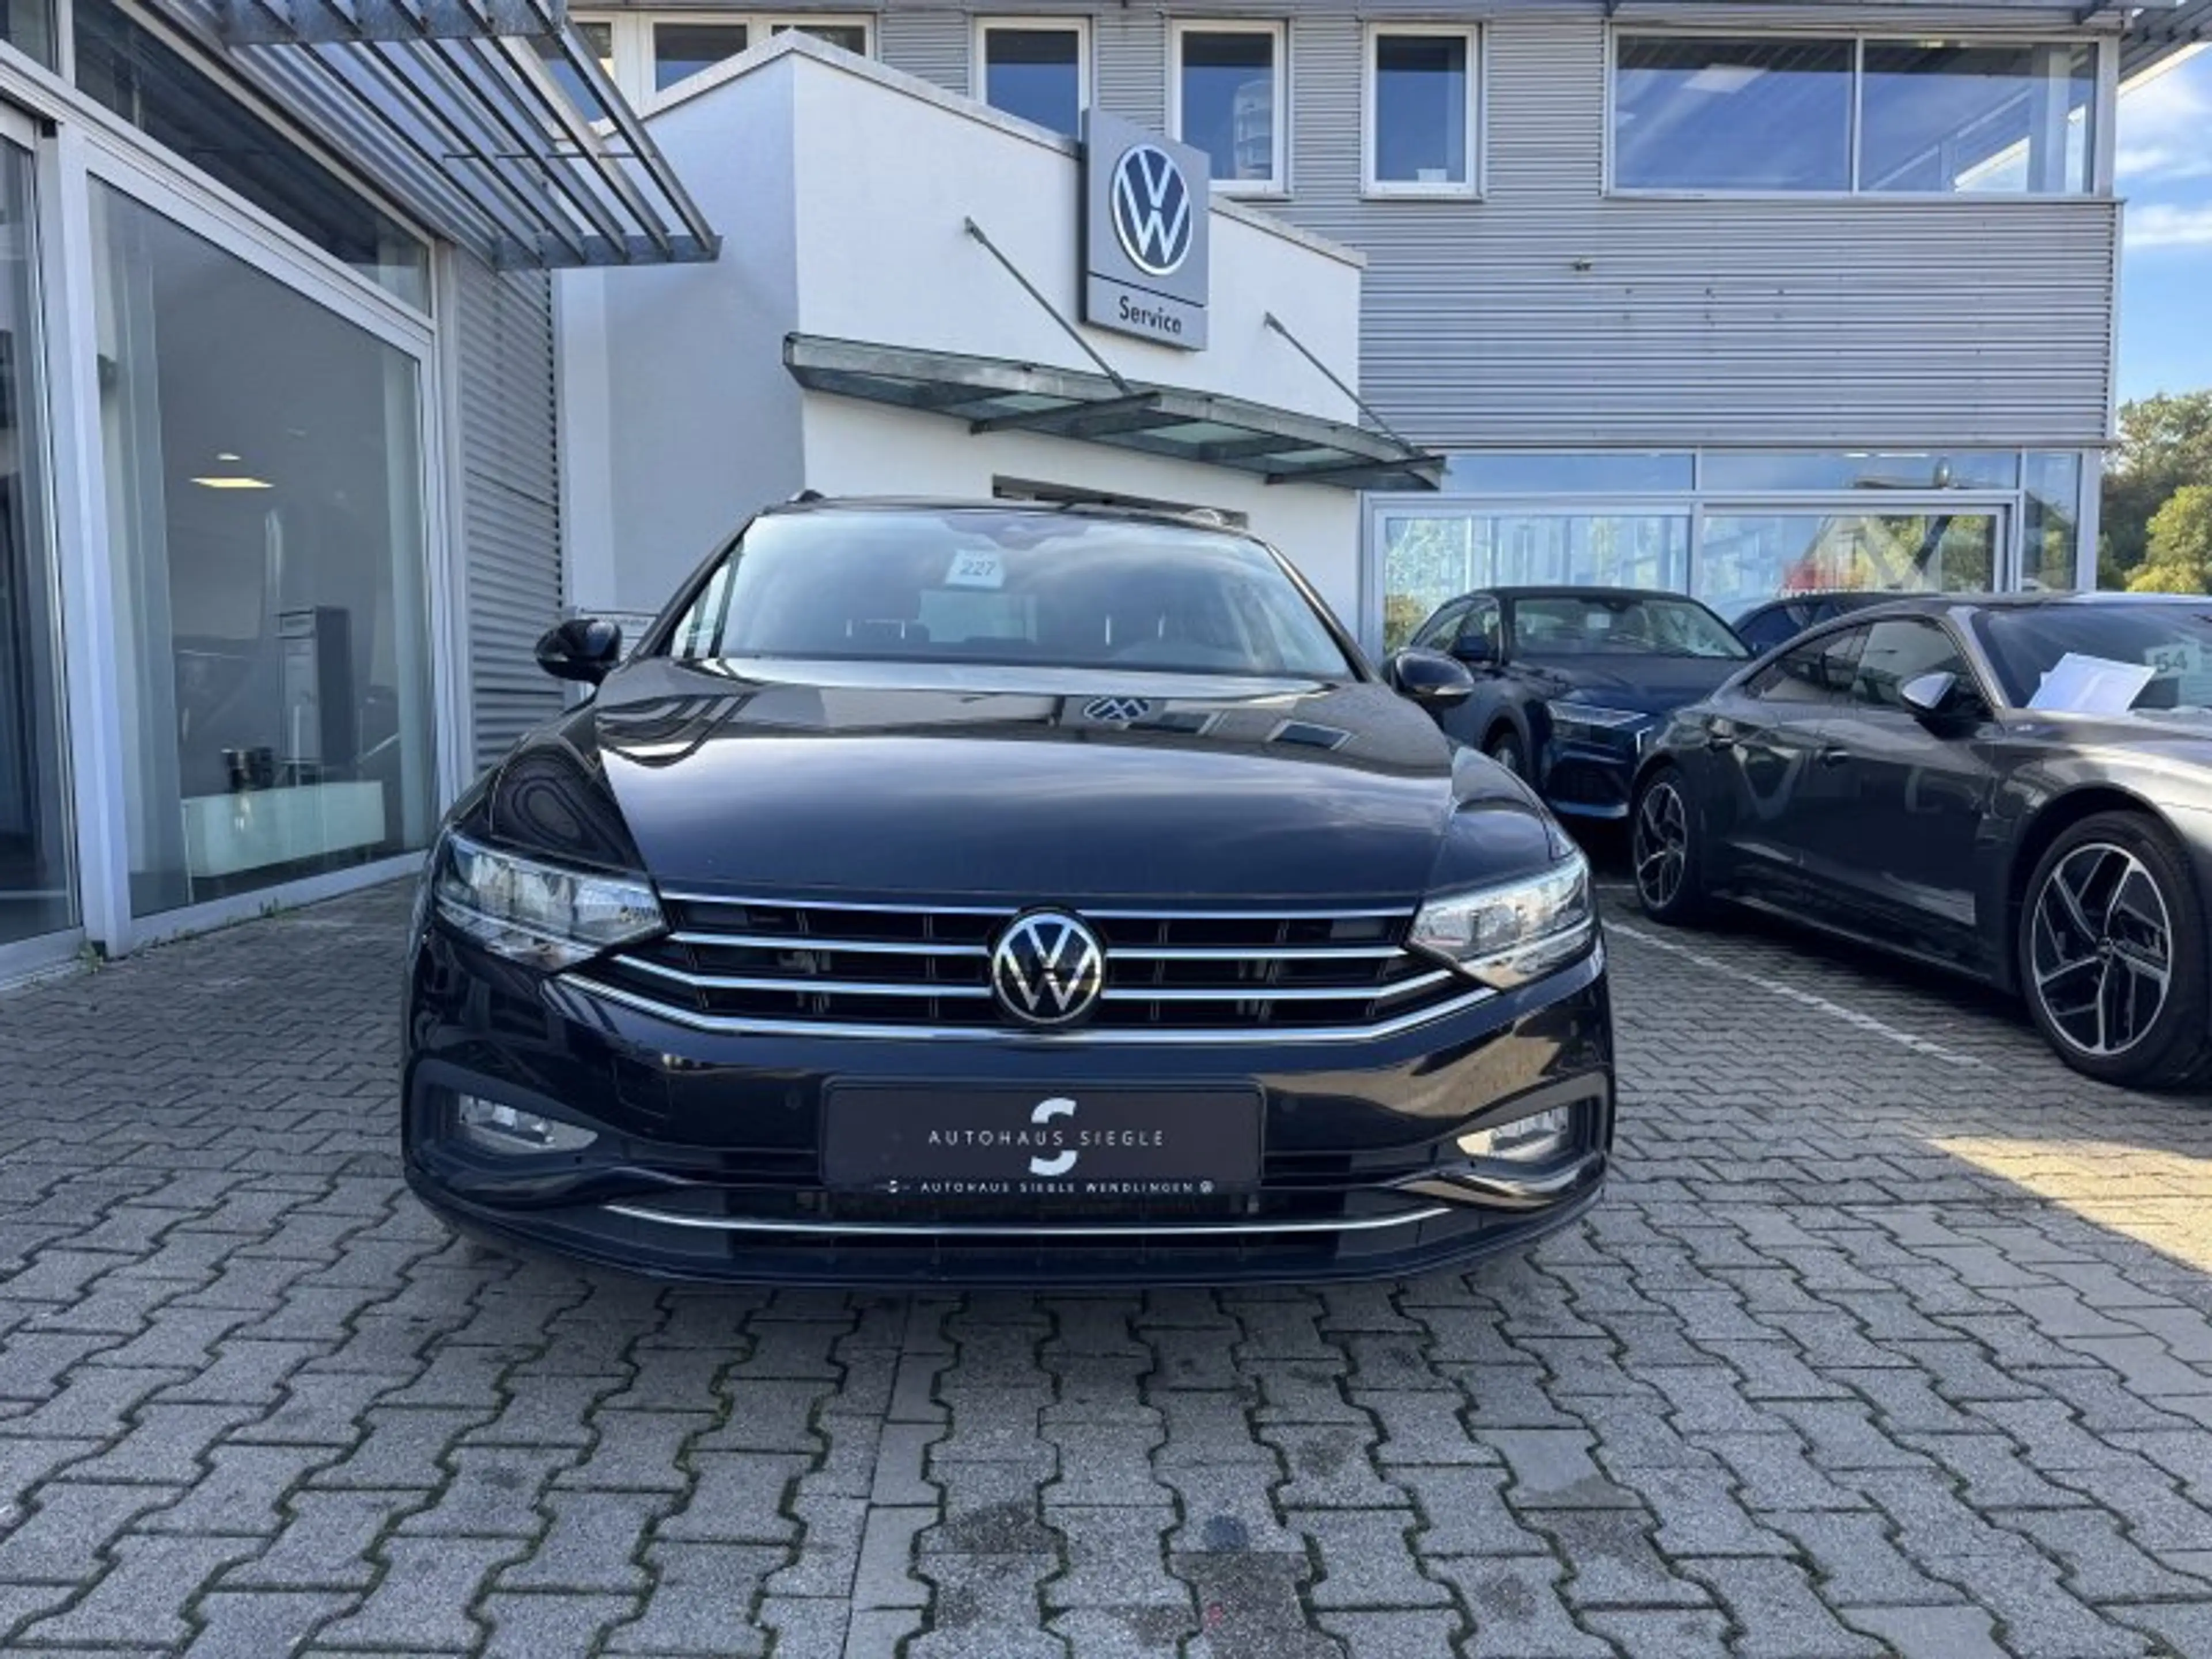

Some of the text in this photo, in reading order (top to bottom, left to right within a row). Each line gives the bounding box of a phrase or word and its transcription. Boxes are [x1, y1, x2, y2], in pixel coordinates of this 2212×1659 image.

[1115, 145, 1192, 272] VW
[1119, 295, 1182, 335] Service
[959, 559, 997, 576] 227
[993, 914, 1101, 1023] VW
[928, 1130, 1164, 1146] AUTOHAUS SIEGLE
[921, 1181, 1009, 1193] AUTOHAUS
[1020, 1181, 1075, 1193] SIEGLE
[1086, 1181, 1192, 1193] WENDLINGEN
